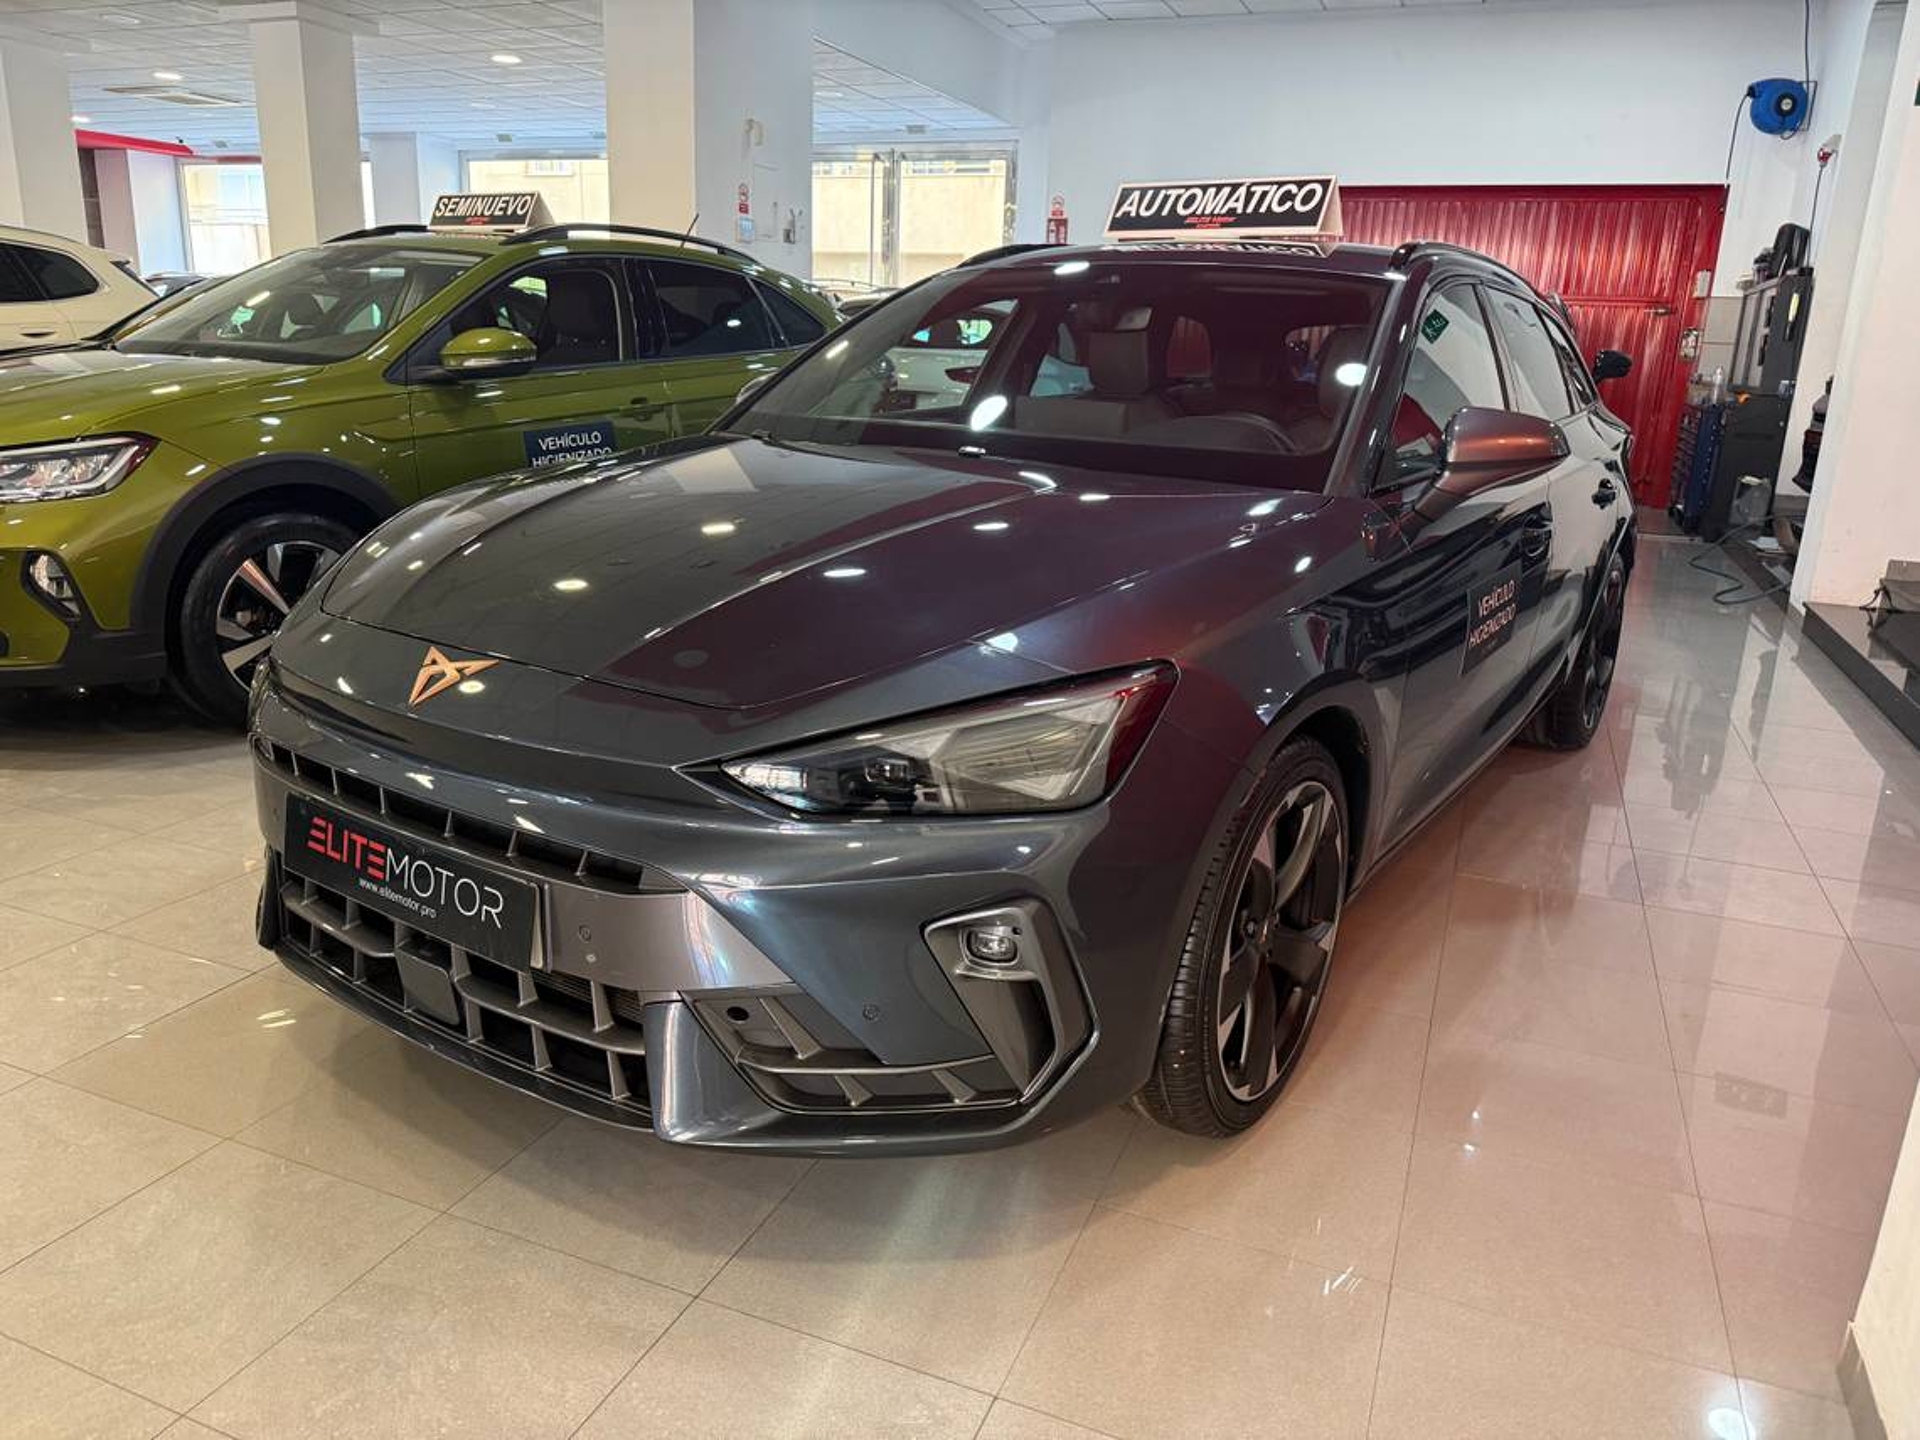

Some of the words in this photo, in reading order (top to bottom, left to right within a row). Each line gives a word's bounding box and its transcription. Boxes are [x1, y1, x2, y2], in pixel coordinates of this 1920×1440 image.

[435, 194, 531, 216] SEMINUEVO
[1115, 183, 1323, 217] AUTOMÁTICO
[538, 430, 602, 451] VEHÍCULO
[1478, 579, 1515, 618] VEHÍCULO
[1468, 603, 1517, 650] HIGIENIZADO
[307, 815, 504, 930] ELITEMOTOR
